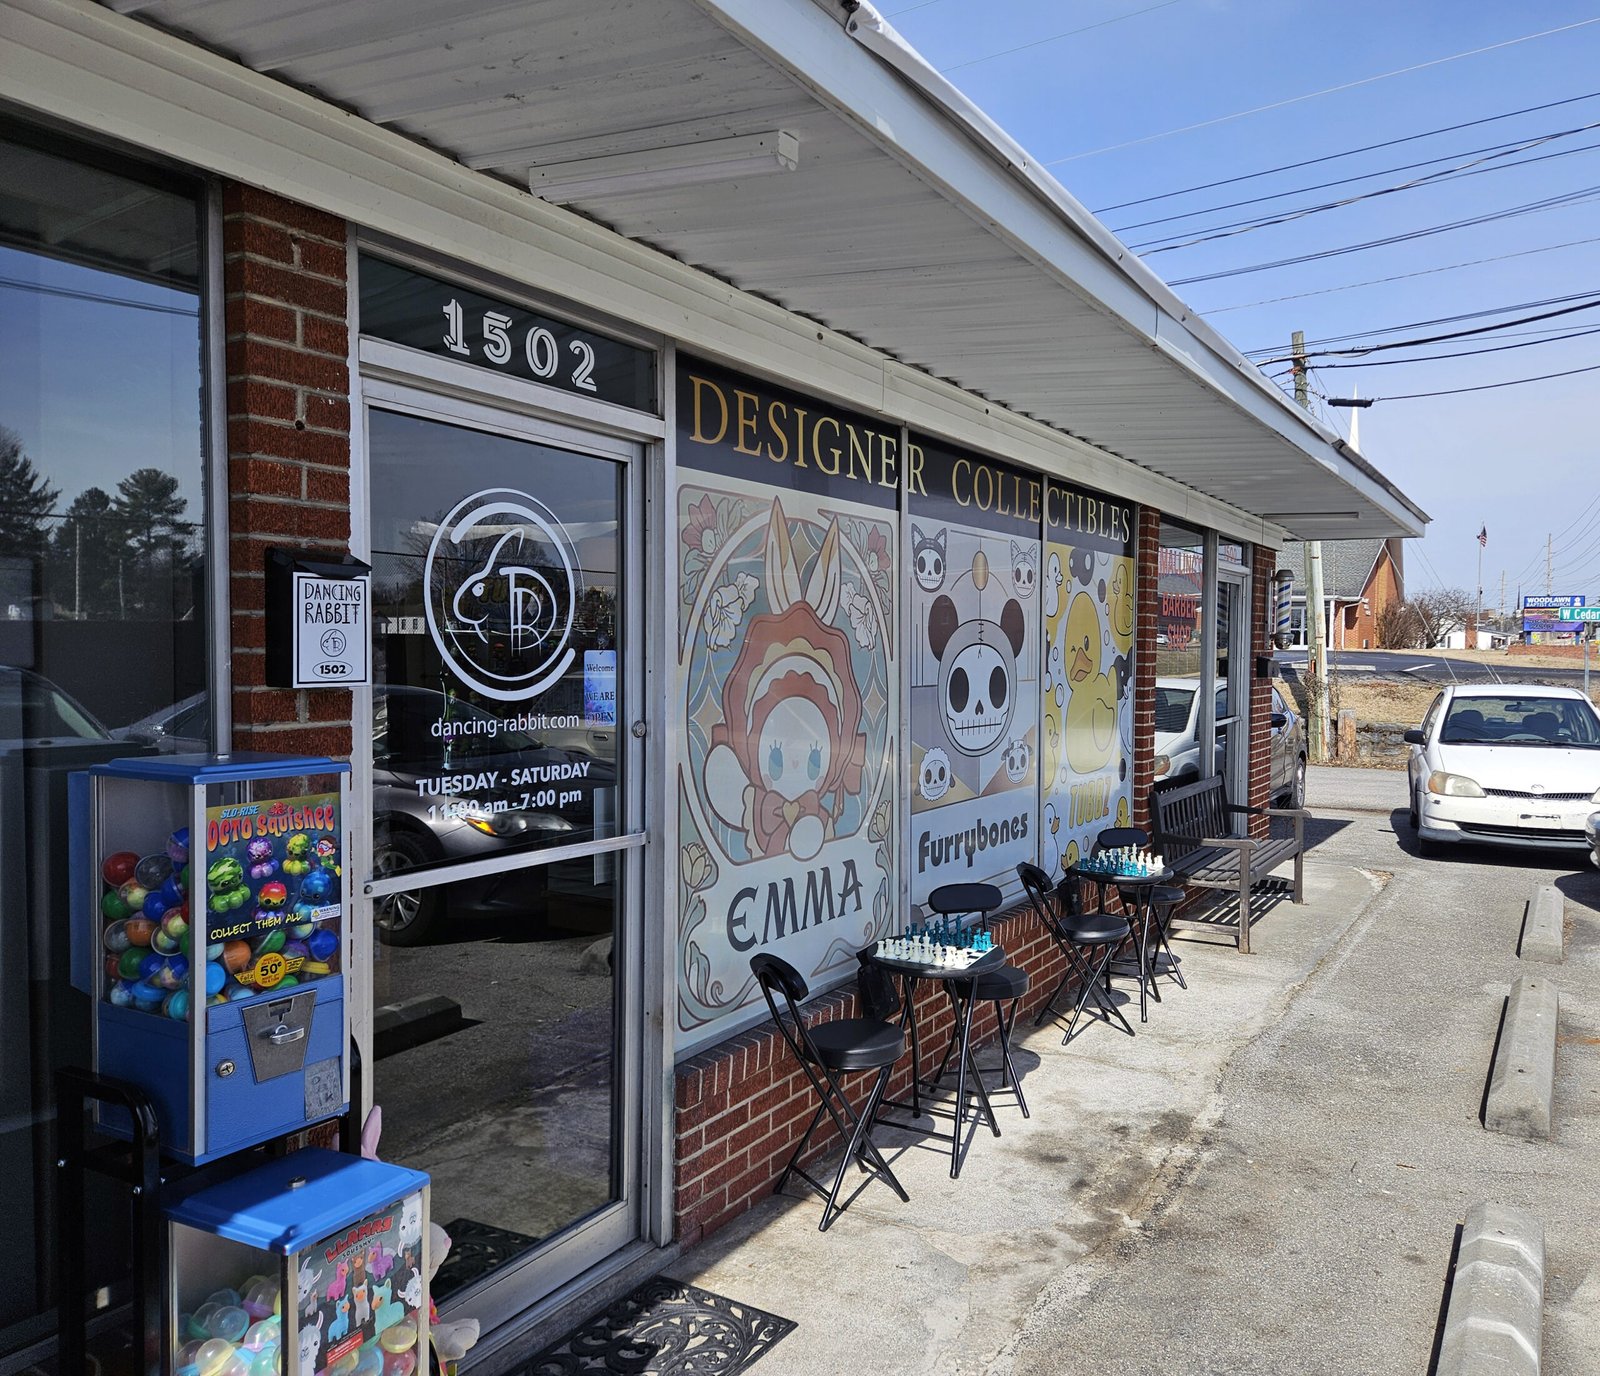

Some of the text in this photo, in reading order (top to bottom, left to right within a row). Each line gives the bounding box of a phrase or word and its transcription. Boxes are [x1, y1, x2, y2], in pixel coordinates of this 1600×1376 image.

[442, 298, 598, 393] 1502
[688, 375, 1131, 544] DESIGNER COLLECTIBLES
[305, 583, 361, 601] DANCING
[305, 602, 360, 624] RABBIT
[1162, 592, 1197, 619] BARBER
[1563, 609, 1570, 619] W
[320, 665, 346, 674] 1502
[586, 663, 614, 672] Welcome
[586, 691, 615, 701] WE ARE
[431, 713, 580, 738] dancing-rabbit.com
[586, 711, 614, 722] OPEN
[416, 771, 499, 797] TUESDAY
[511, 761, 591, 786] SATURDAY
[221, 805, 260, 819] SLO-RISE
[427, 799, 480, 824] 11:00
[483, 801, 508, 816] am
[520, 789, 556, 810] 7:00
[559, 788, 582, 807] pm
[1069, 776, 1111, 829] TUBBZ
[727, 859, 863, 952] EMMA
[210, 922, 252, 940] COLLECT
[255, 917, 282, 930] THEM
[285, 913, 303, 923] ALL
[324, 1215, 394, 1264] LLAMAS
